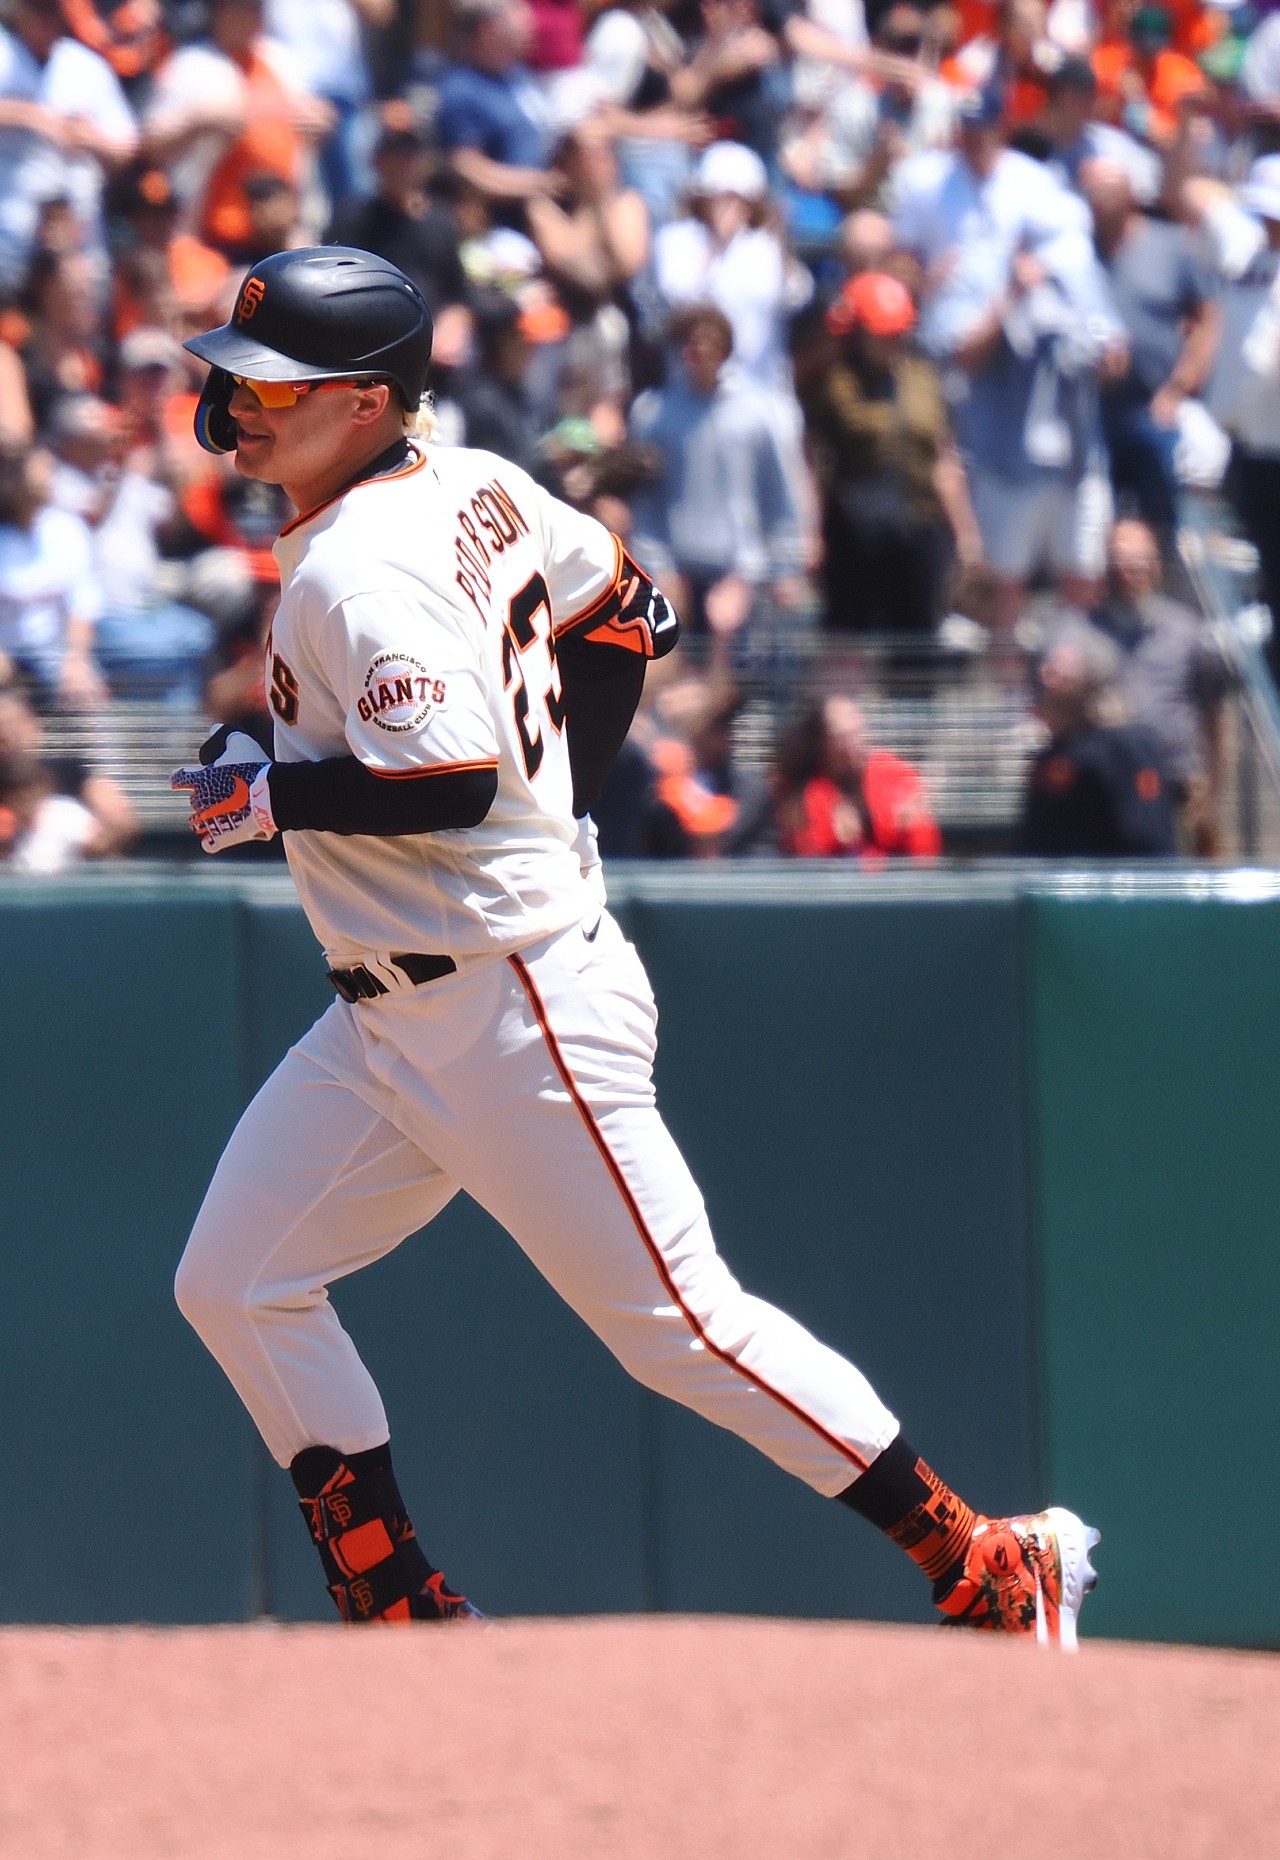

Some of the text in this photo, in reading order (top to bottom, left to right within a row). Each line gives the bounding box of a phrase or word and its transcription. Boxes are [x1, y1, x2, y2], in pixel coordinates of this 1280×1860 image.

[364, 653, 426, 687] SAN FRANCISCO
[500, 568, 567, 782] 23
[357, 676, 446, 722] GIANTS
[373, 703, 431, 732] BASEBALL CLUB
